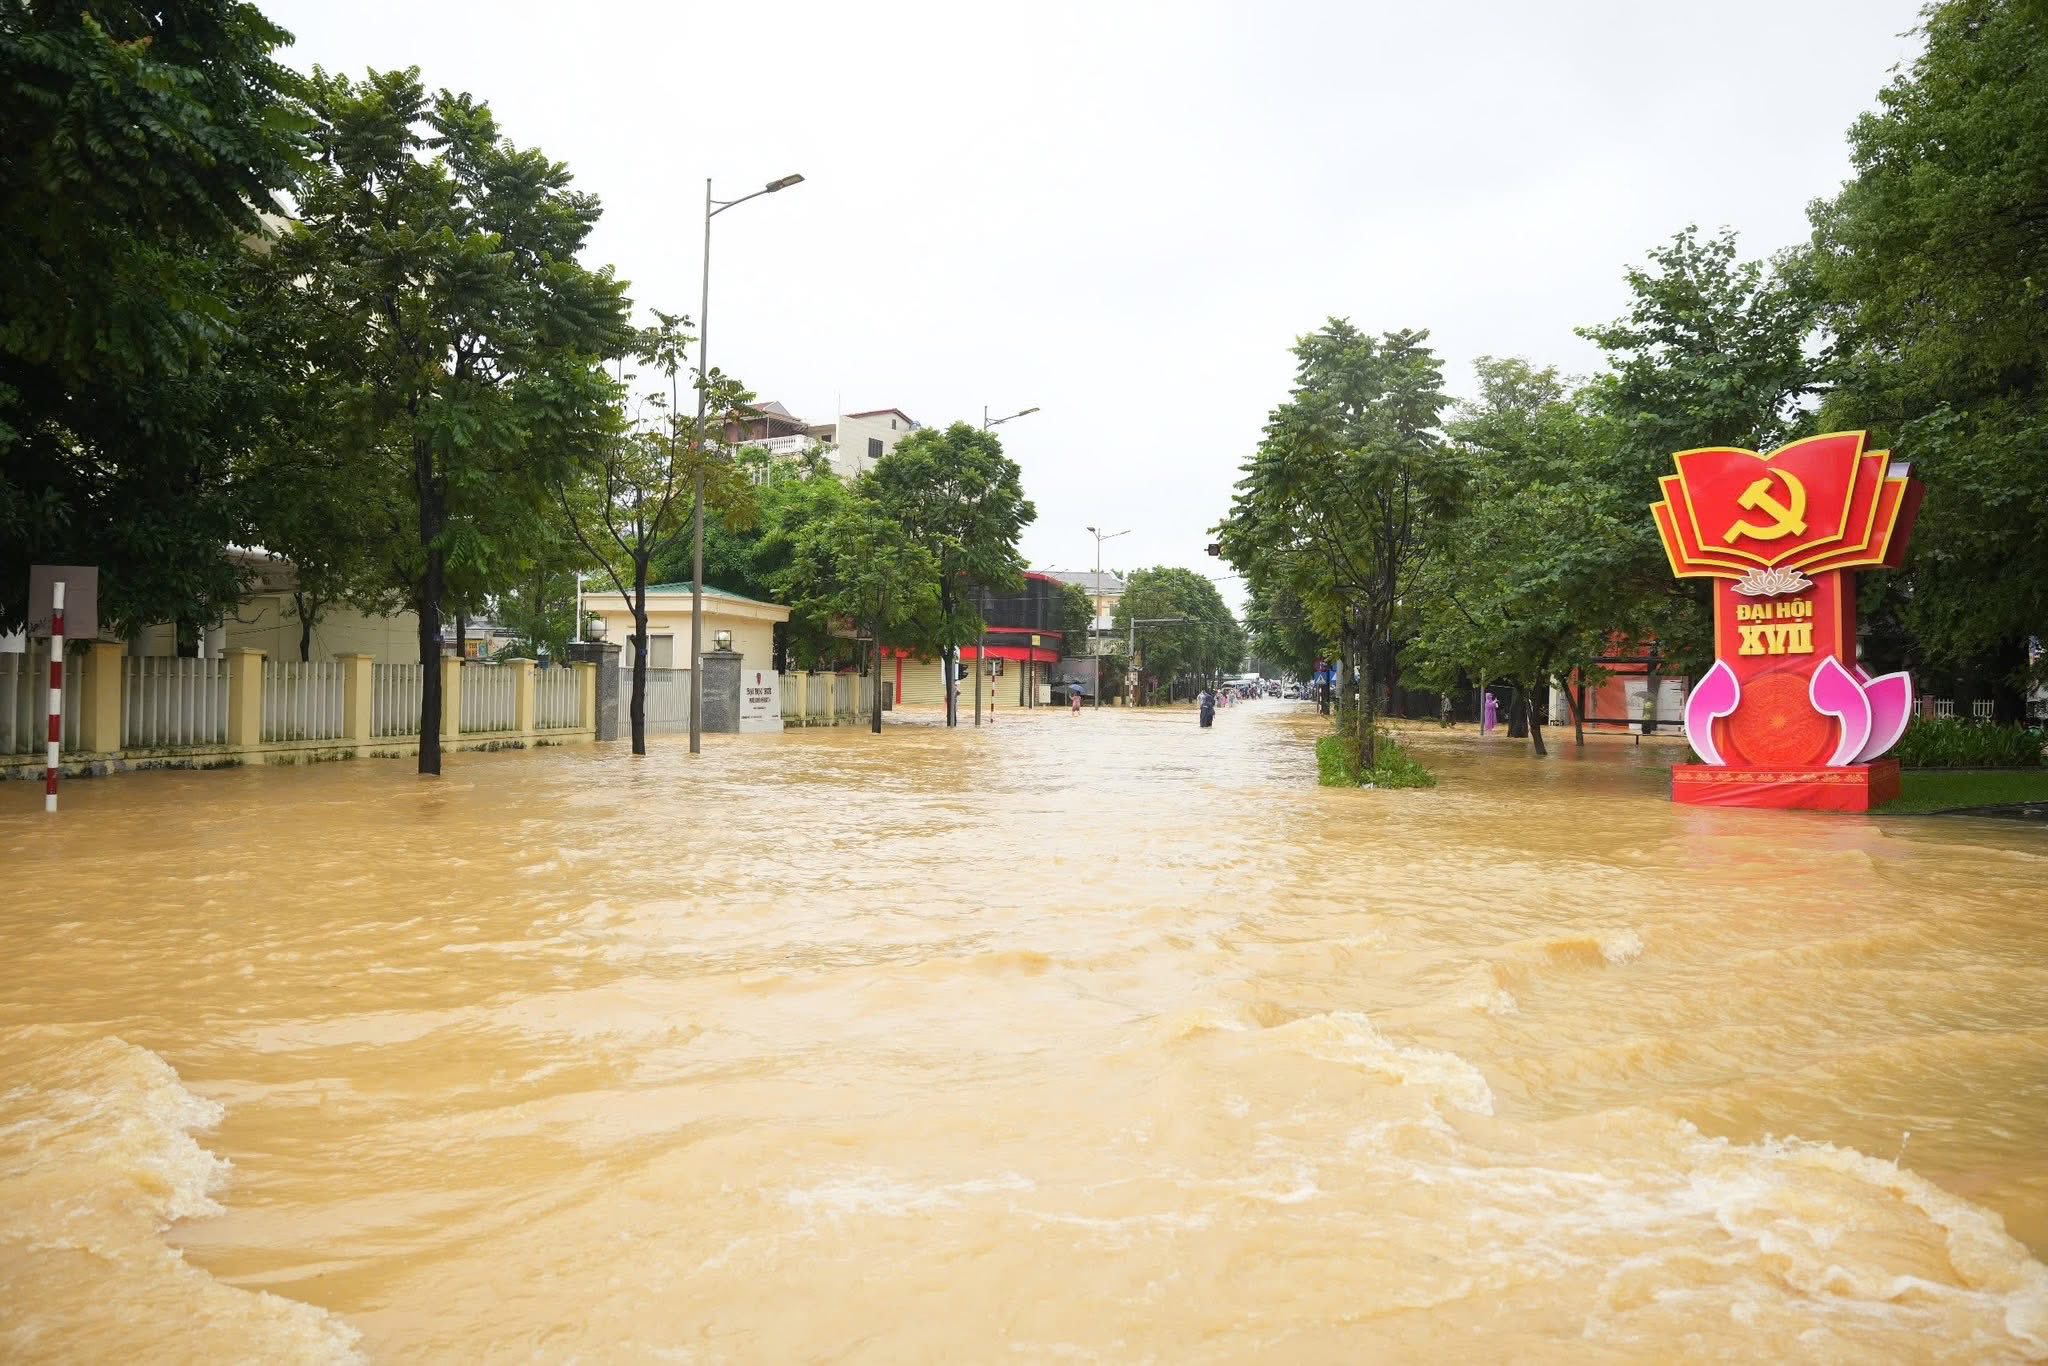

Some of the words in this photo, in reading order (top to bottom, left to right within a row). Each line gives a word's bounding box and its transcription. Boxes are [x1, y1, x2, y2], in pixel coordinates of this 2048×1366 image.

[1736, 604, 1773, 623] ĐẠI
[1776, 598, 1812, 622] HỘI
[1738, 623, 1814, 655] XVII
